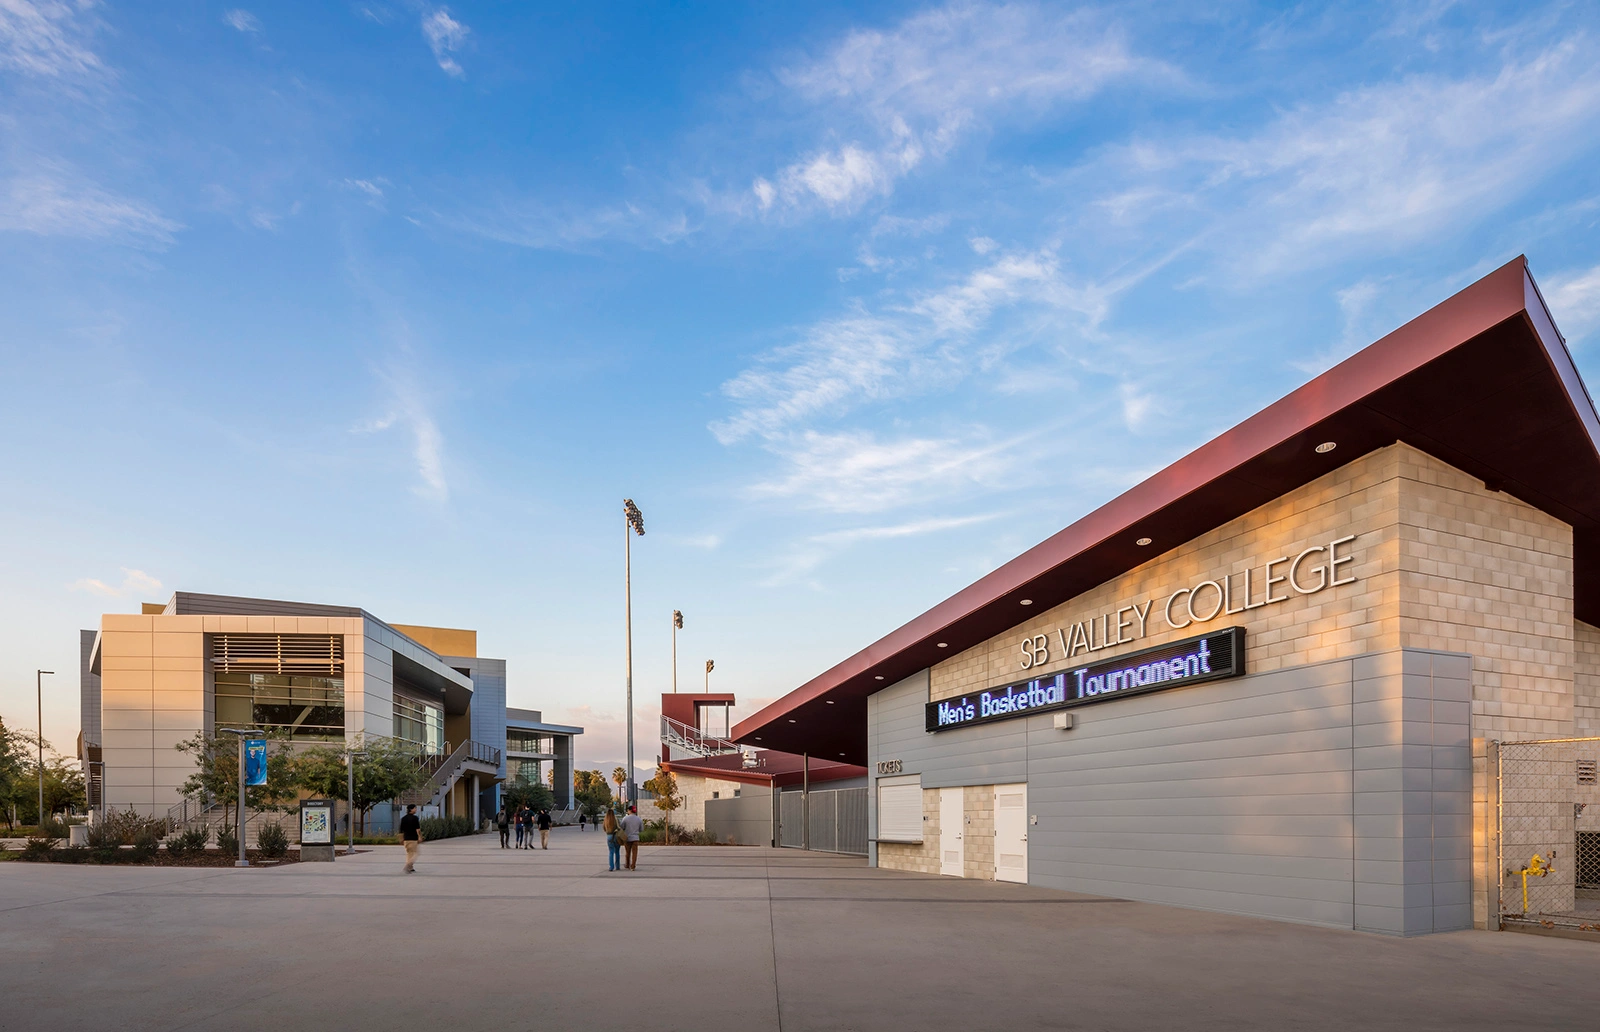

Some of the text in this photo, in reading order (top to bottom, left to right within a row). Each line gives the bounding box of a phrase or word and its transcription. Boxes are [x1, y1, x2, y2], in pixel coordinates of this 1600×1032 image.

[1020, 534, 1358, 670] SB VALLEY COLLEGE
[938, 639, 1211, 726] Men's Basketball Tournament
[876, 758, 902, 774] TICKETS
